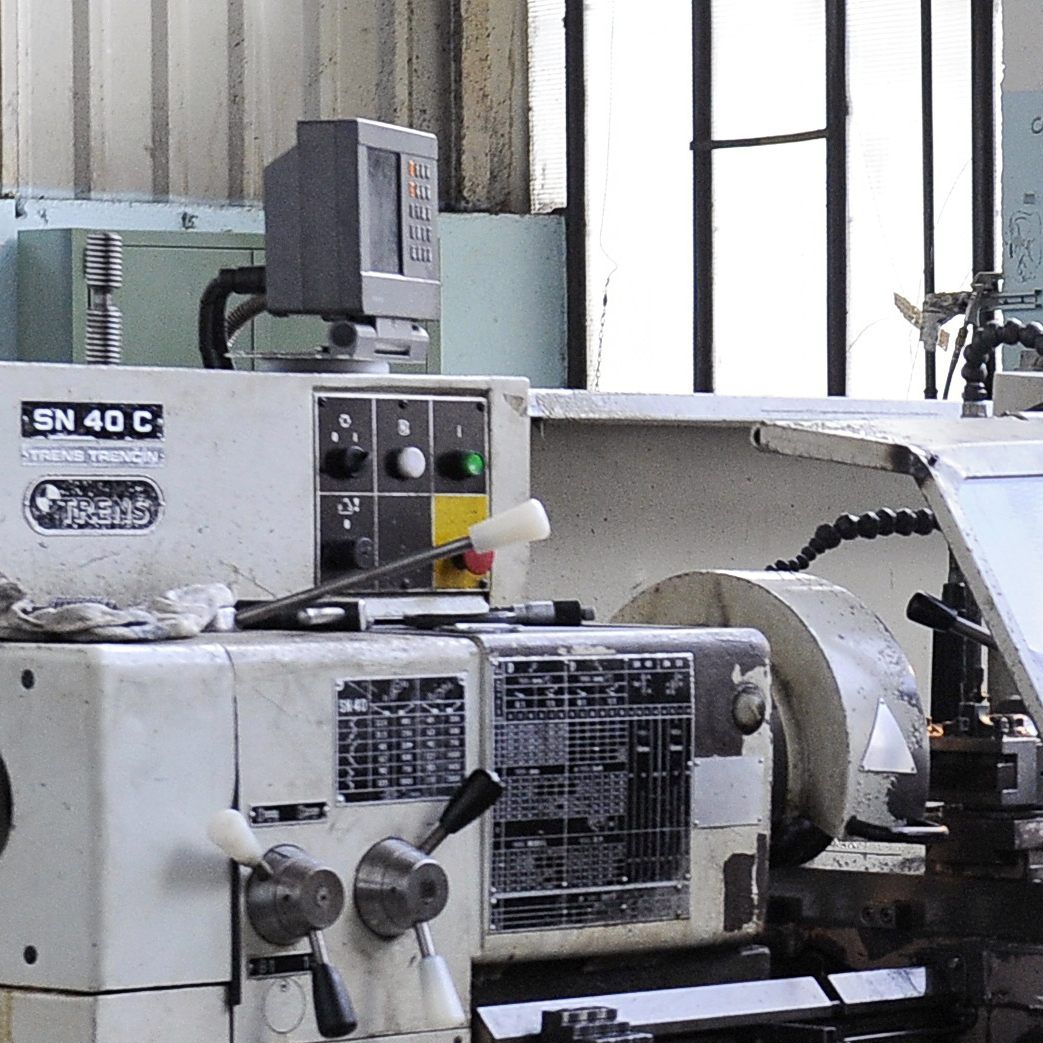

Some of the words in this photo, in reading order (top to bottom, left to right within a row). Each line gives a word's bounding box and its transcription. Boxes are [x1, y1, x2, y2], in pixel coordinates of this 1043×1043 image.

[33, 408, 75, 431] SN
[83, 409, 124, 432] 40
[133, 410, 153, 433] C
[29, 449, 84, 463] TRENS
[61, 497, 151, 525] TRENS
